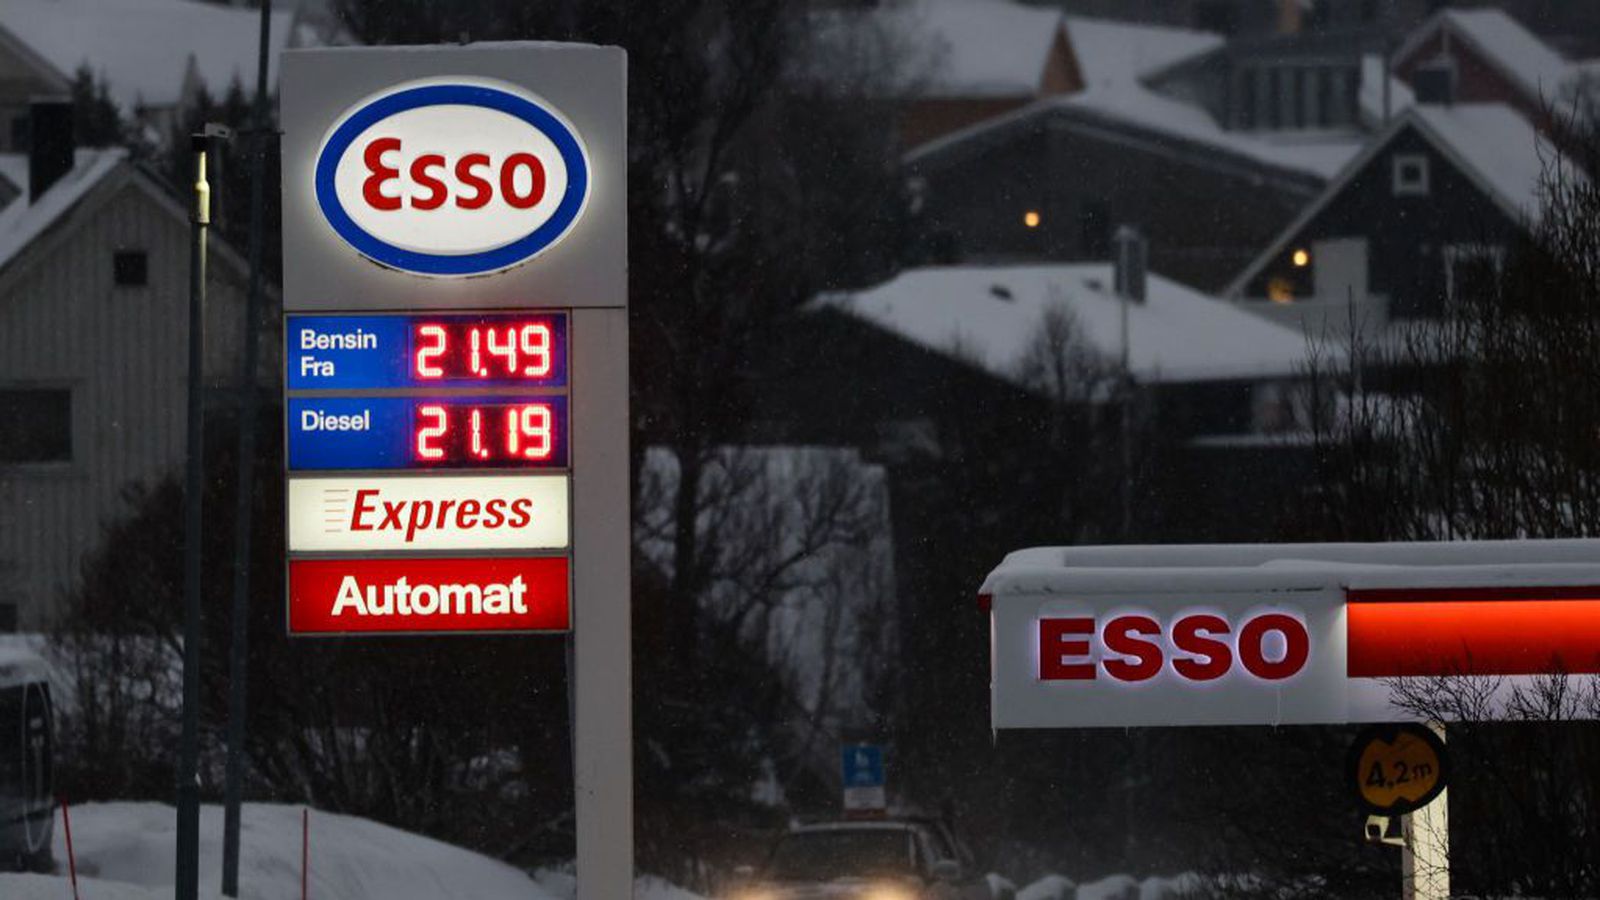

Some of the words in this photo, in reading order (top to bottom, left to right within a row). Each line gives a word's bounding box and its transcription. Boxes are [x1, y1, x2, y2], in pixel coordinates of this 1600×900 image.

[362, 137, 546, 211] Esso
[301, 328, 377, 349] Bensin
[417, 325, 550, 377] 21.49
[301, 356, 335, 376] Fra
[301, 409, 370, 431] Diesel
[417, 406, 551, 458] 21.19
[350, 489, 533, 542] Express
[331, 573, 528, 616] Automat
[1039, 614, 1310, 682] ESSO
